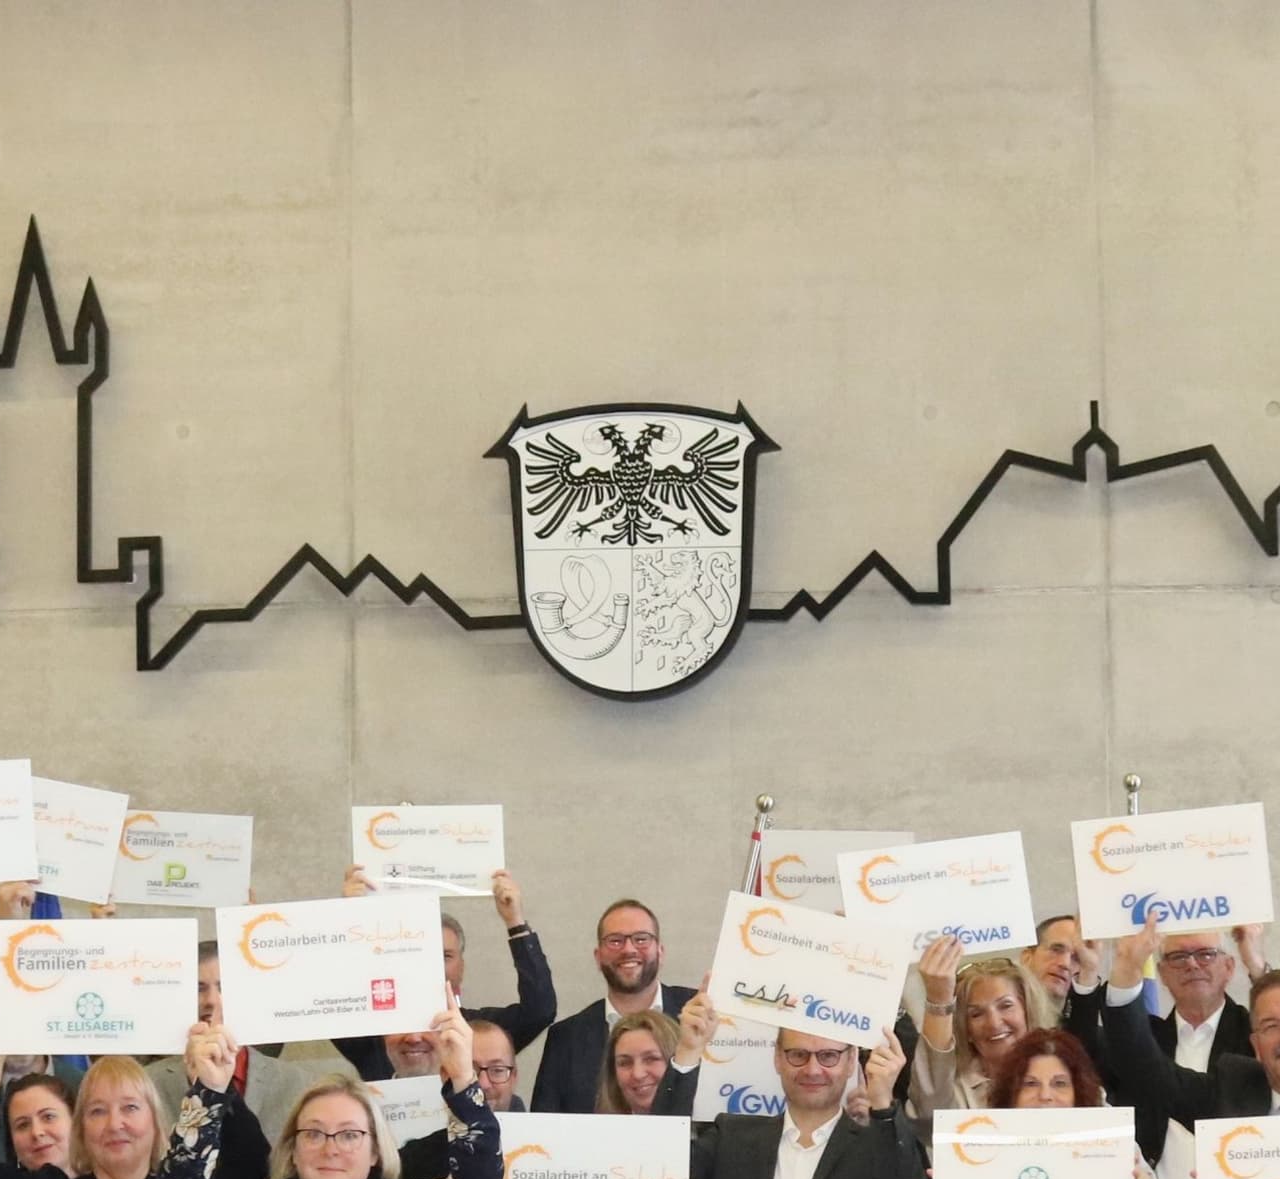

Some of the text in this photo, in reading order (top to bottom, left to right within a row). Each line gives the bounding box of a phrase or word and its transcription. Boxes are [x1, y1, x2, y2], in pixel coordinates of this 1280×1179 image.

[127, 836, 175, 848] Familien
[1102, 841, 1167, 858] Sozialarbeit
[1169, 840, 1184, 850] an
[775, 873, 837, 885] Sozialarbeit
[868, 871, 932, 887] Sozialarbeit
[934, 869, 948, 880] an
[1147, 896, 1230, 922] GWAB
[251, 934, 327, 950] Sozialarbeit
[331, 933, 346, 943] an
[750, 924, 813, 952] Sozialarbeit
[815, 942, 829, 953] an
[959, 926, 1011, 944] GWAB
[17, 945, 105, 958] Begegnungs- und
[16, 957, 86, 971] Familien
[46, 1020, 135, 1032] ST. ELISABETH
[817, 1007, 871, 1031] GWAB
[742, 1094, 786, 1115] GW
